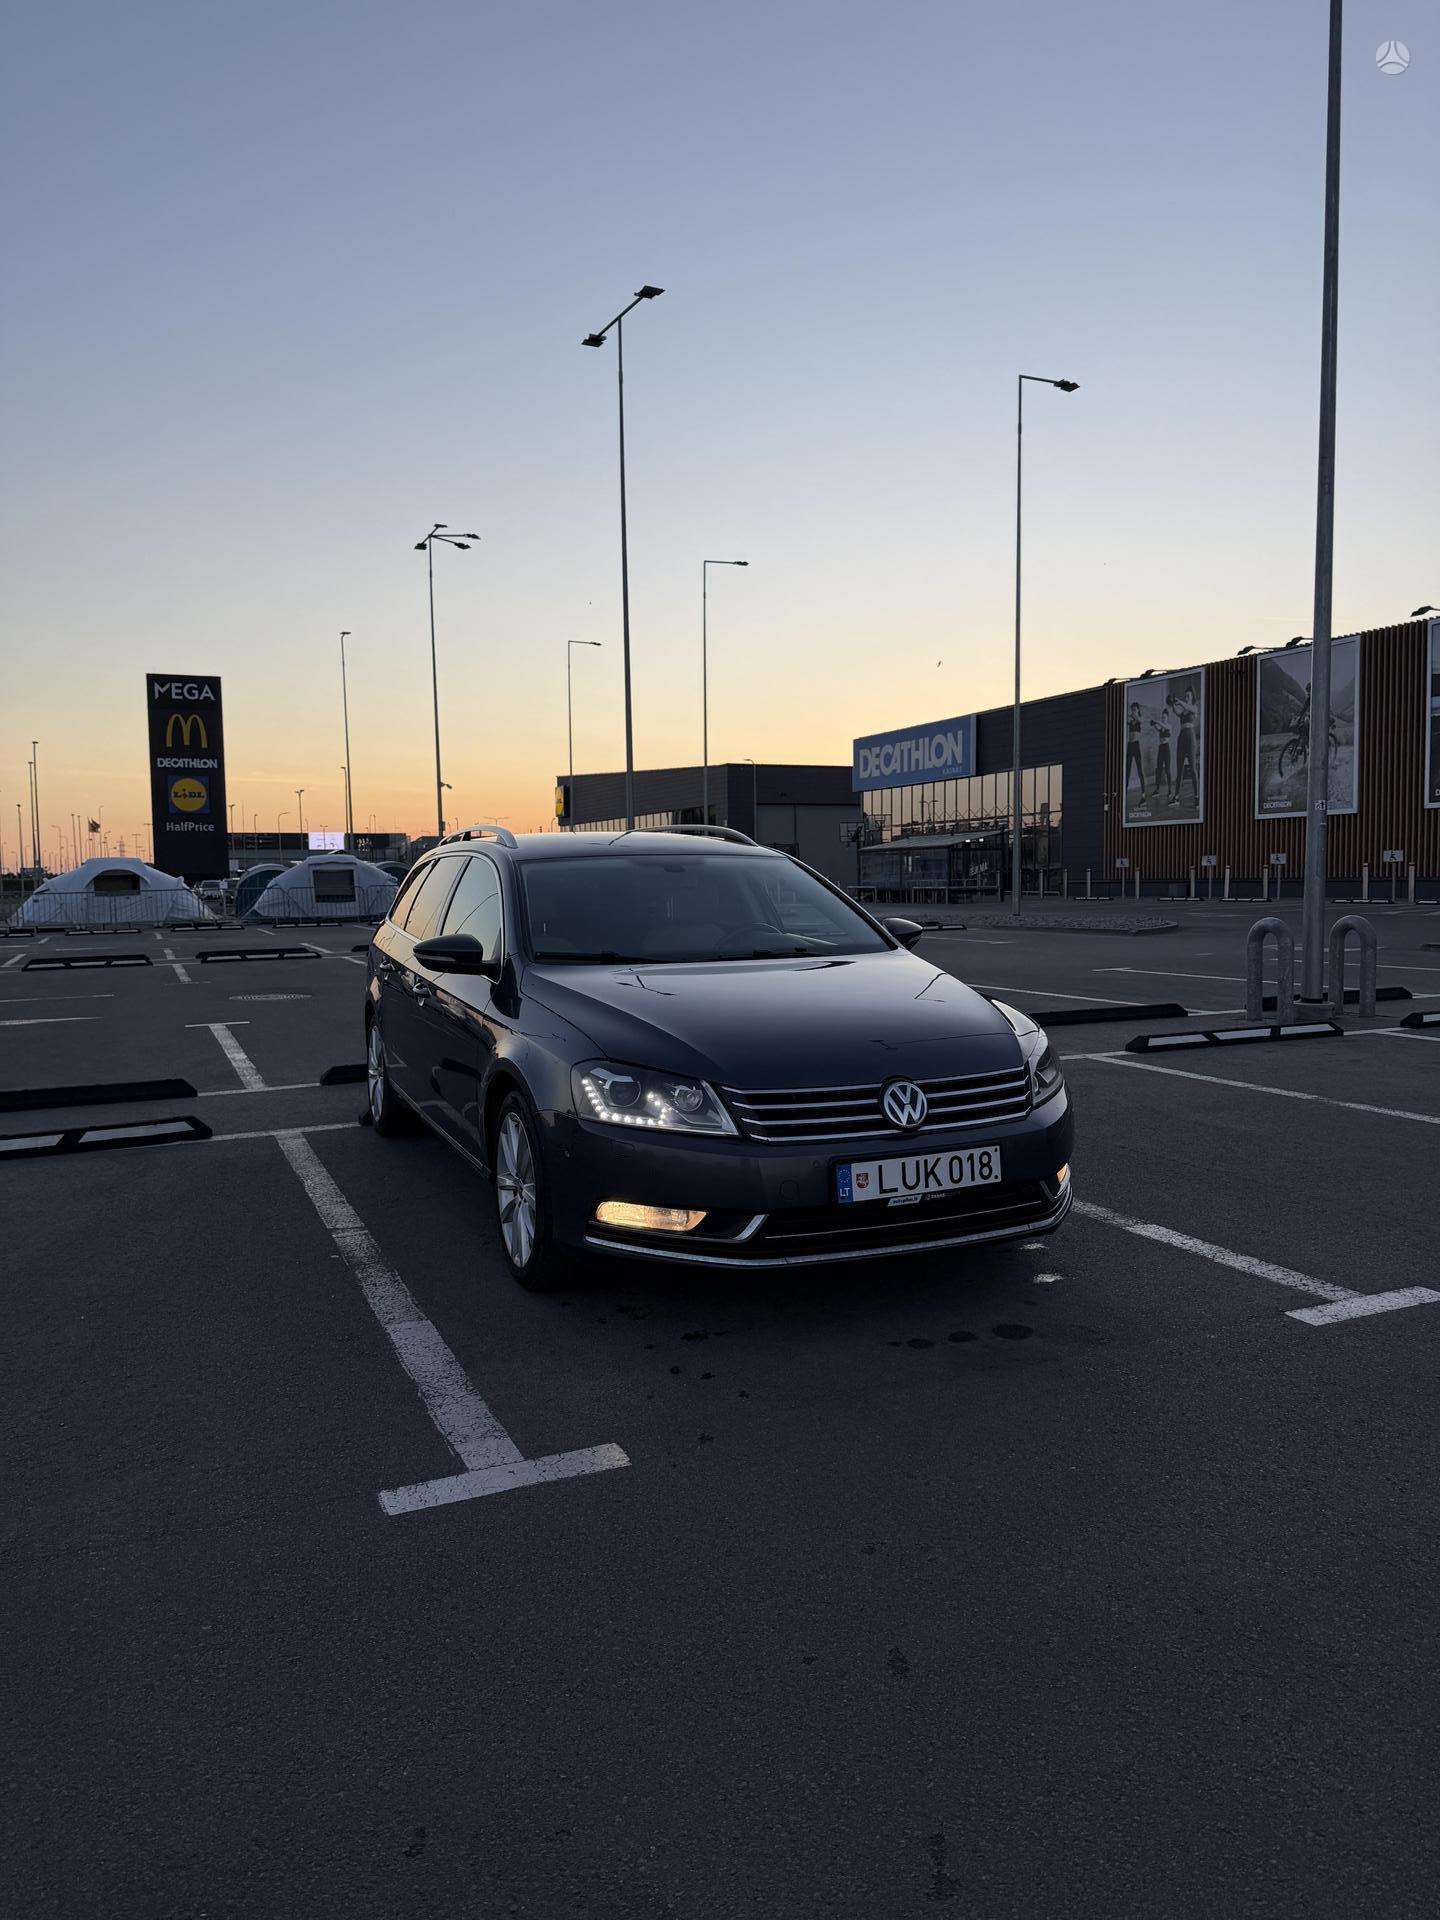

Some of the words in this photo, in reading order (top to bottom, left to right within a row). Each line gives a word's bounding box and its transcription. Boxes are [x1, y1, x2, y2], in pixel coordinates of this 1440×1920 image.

[154, 682, 216, 700] MEGA
[859, 730, 963, 779] DECATHLON
[157, 757, 218, 769] DECATHLON
[166, 821, 215, 832] HalfPrice
[884, 1081, 928, 1127] VW
[839, 1187, 850, 1197] LT
